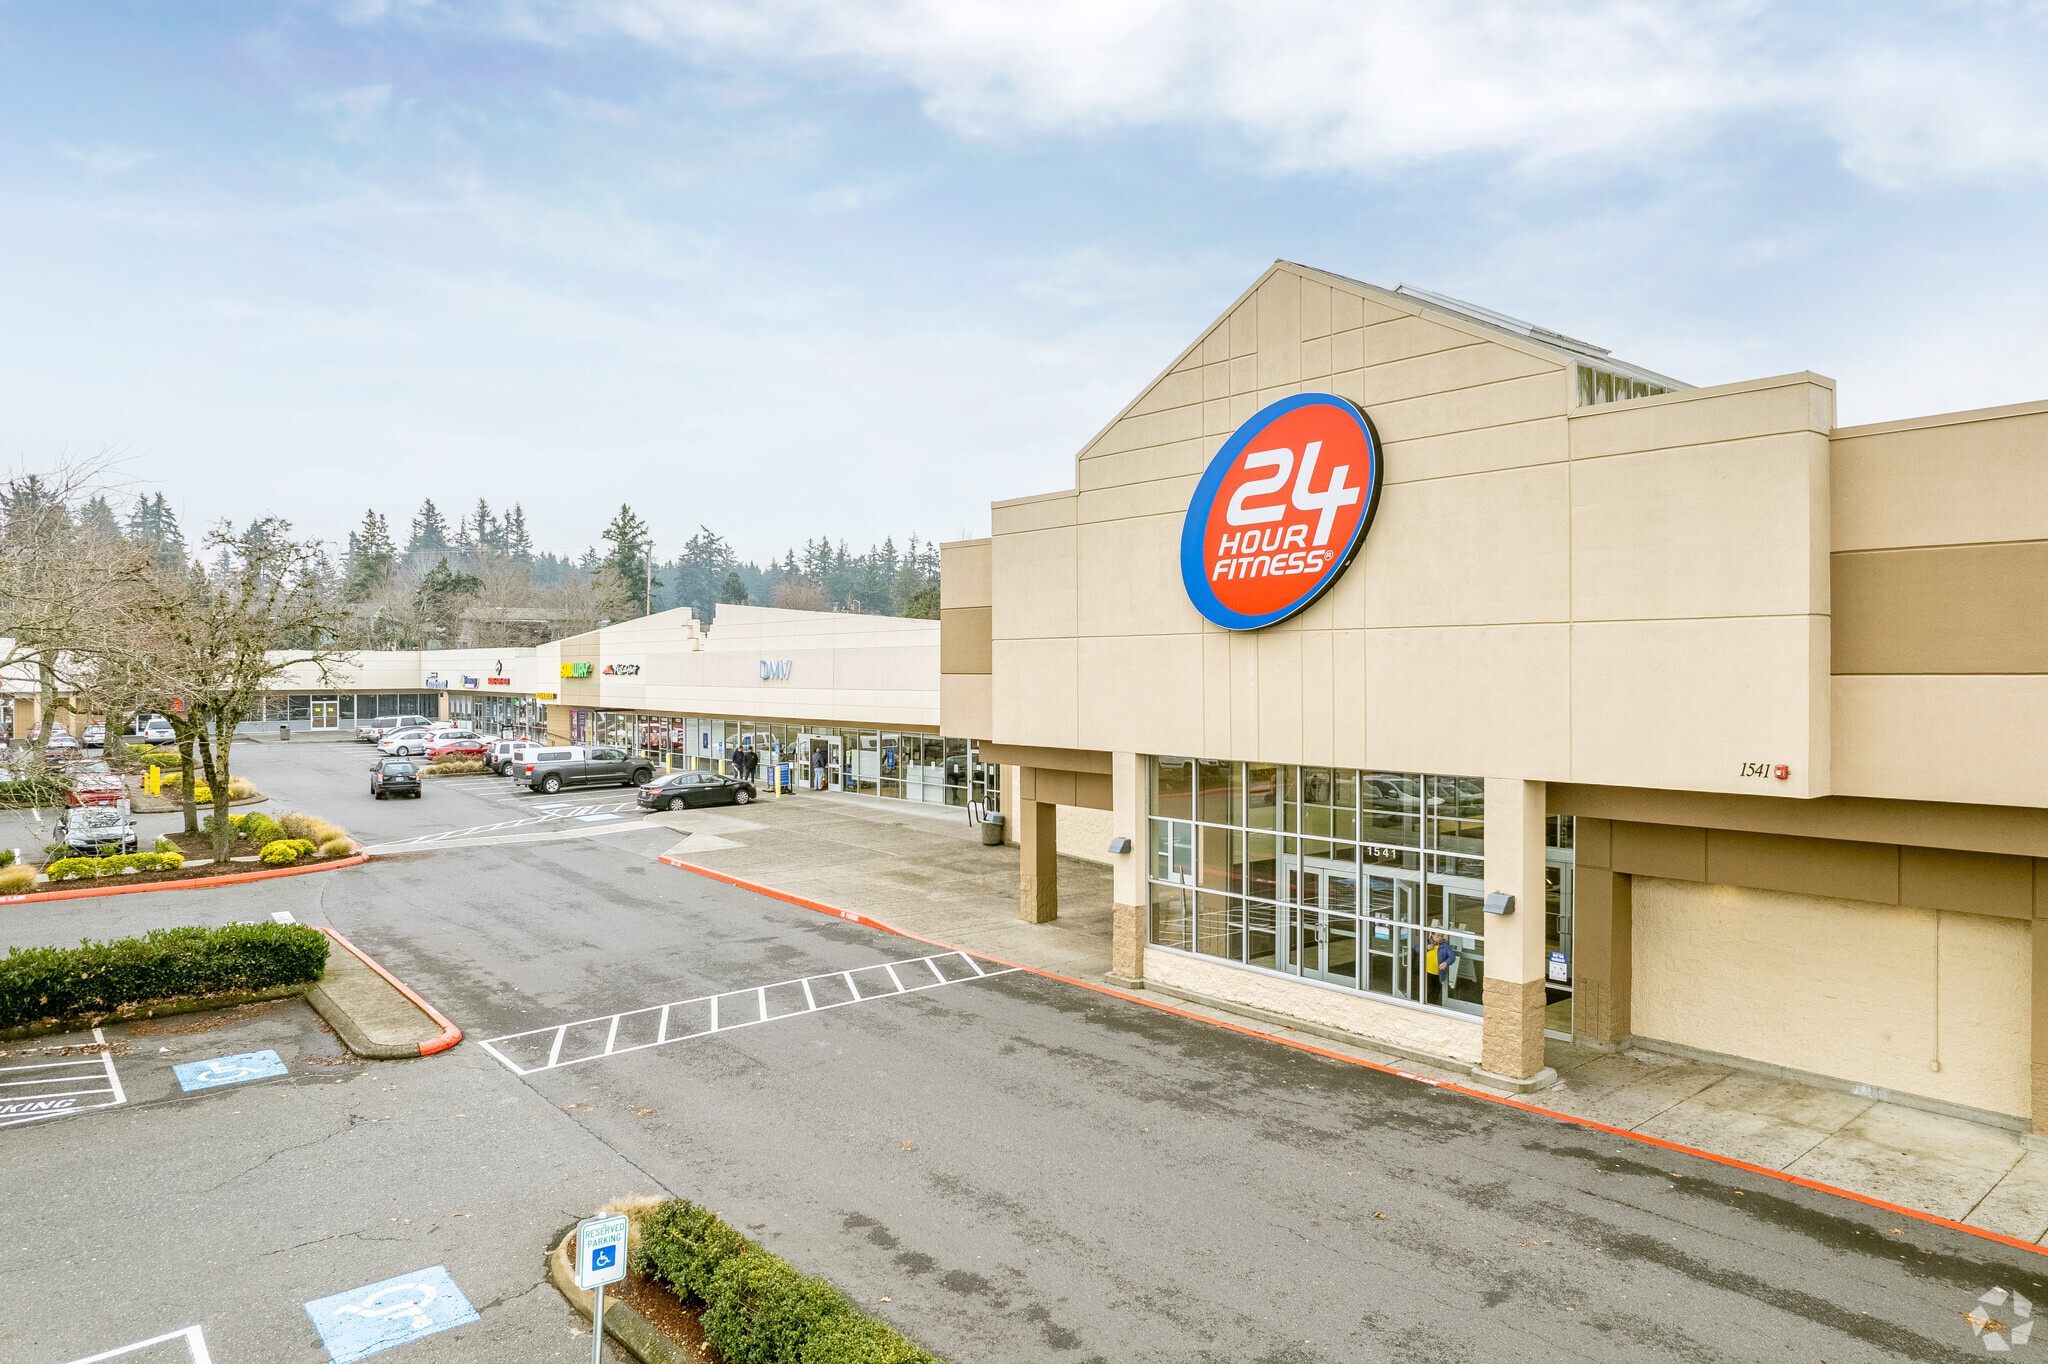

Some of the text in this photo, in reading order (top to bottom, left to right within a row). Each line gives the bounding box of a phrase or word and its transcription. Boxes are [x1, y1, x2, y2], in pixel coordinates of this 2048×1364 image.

[1226, 440, 1361, 546] 24
[1217, 524, 1309, 556] HOUR
[1211, 549, 1326, 581] FITNESS
[560, 661, 592, 678] SUBWAY
[759, 659, 793, 680] DMV
[1740, 762, 1771, 778] 1541
[1366, 845, 1397, 860] 1541
[585, 1222, 625, 1240] RESERVED
[587, 1233, 622, 1249] PARKING
